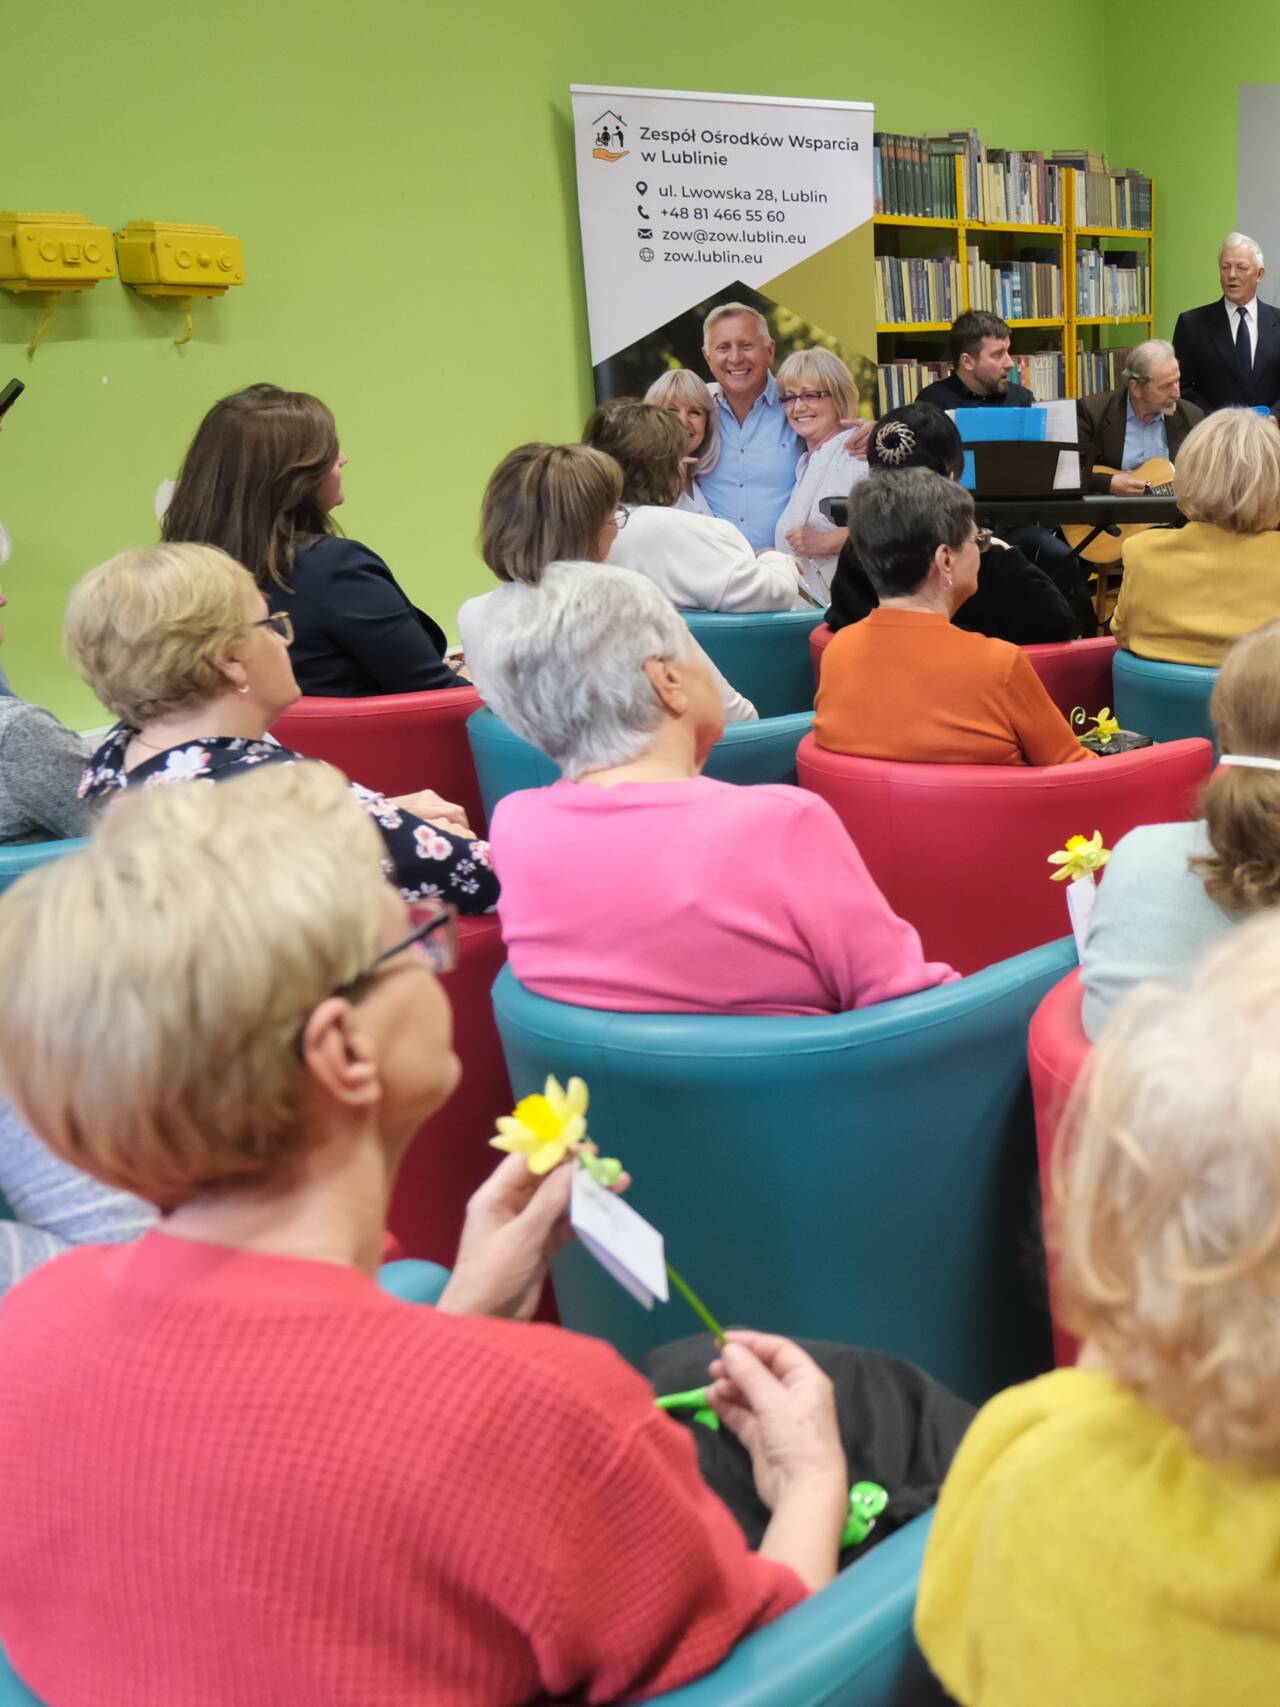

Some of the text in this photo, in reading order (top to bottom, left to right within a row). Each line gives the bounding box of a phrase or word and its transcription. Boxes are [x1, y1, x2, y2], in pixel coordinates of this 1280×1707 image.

[639, 126, 860, 152] Zespół Ośrodków Wsparcia
[641, 150, 728, 166] w Lublinie
[658, 185, 828, 203] ul. Lwowska 28, Lublin
[661, 207, 786, 223] +48 81 466 55 60
[662, 229, 806, 245] zow@zow.lublin.eu
[663, 250, 763, 265] zow.lublin.eu
